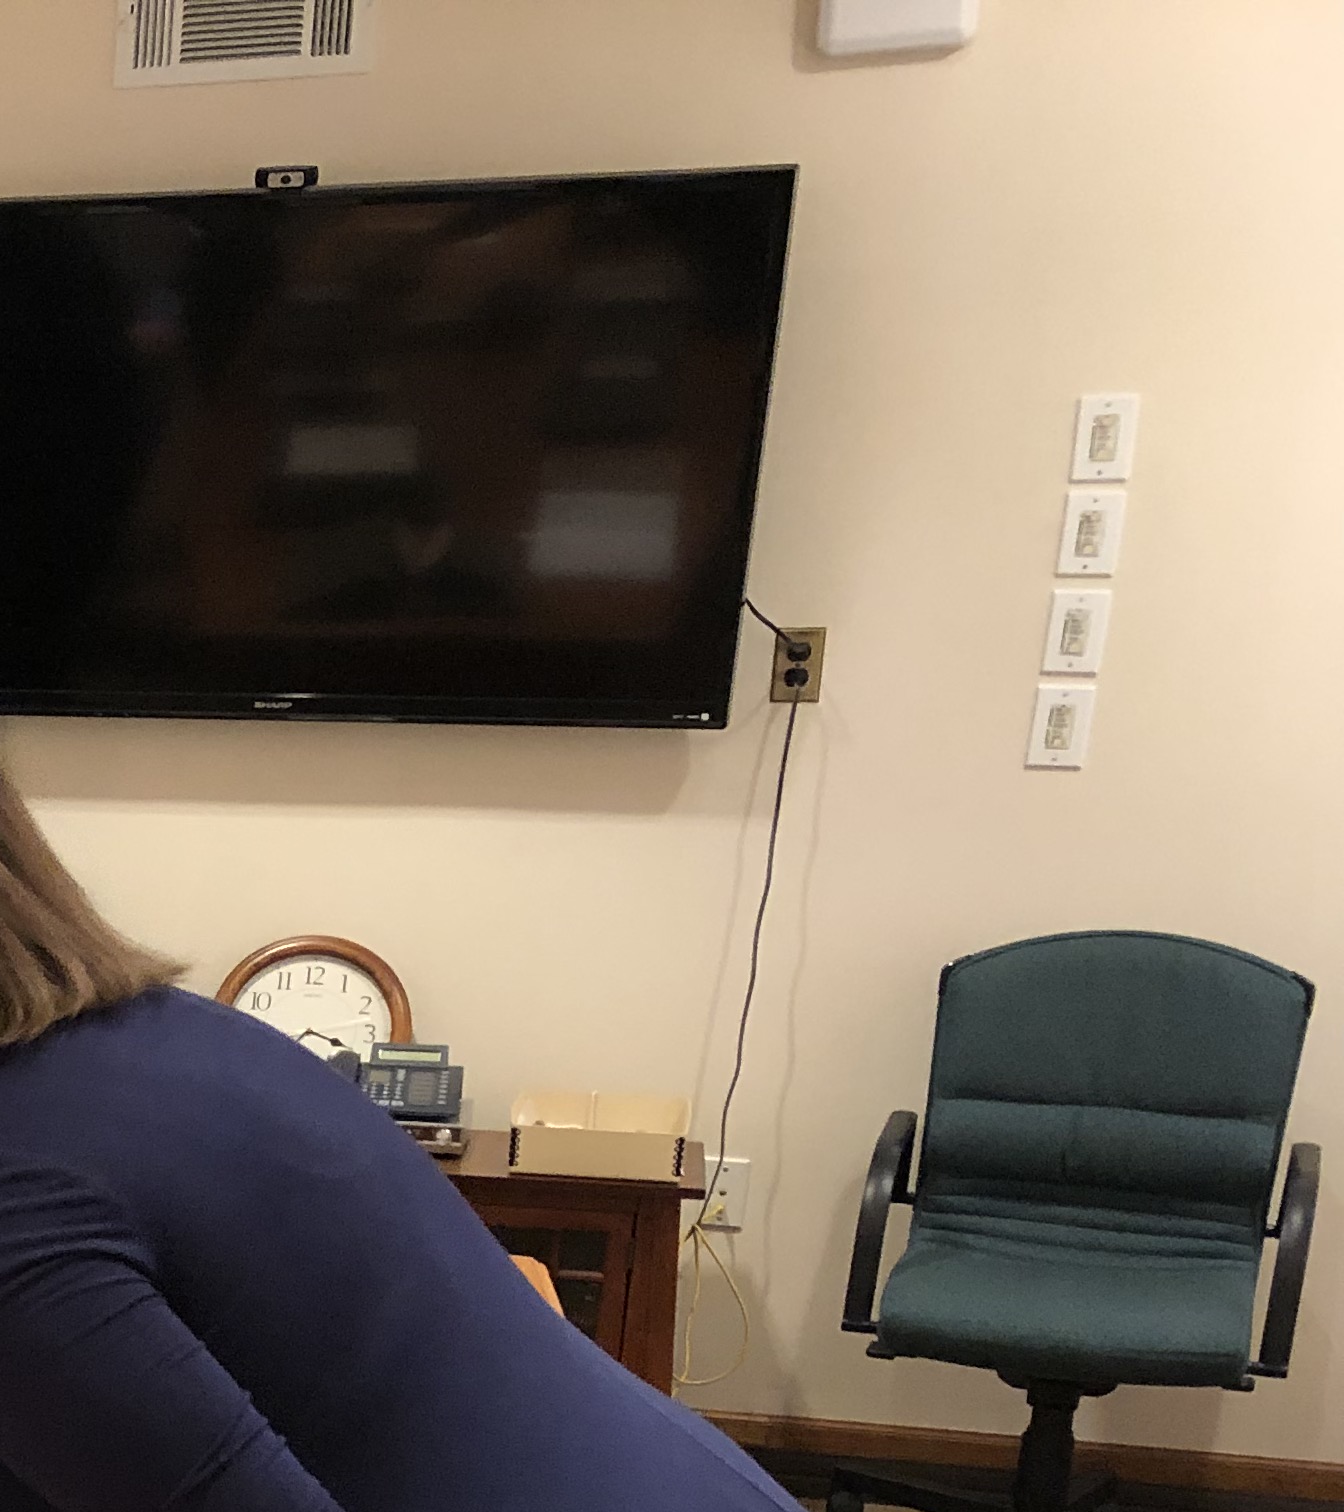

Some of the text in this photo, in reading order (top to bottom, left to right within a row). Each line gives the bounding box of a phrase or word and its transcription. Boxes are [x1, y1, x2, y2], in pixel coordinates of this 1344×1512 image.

[254, 701, 293, 709] SHARP
[277, 971, 292, 991] 11
[305, 966, 326, 986] 12
[341, 974, 348, 993] 1
[250, 991, 272, 1011] 10
[358, 995, 372, 1015] 2
[362, 1024, 376, 1044] 3
